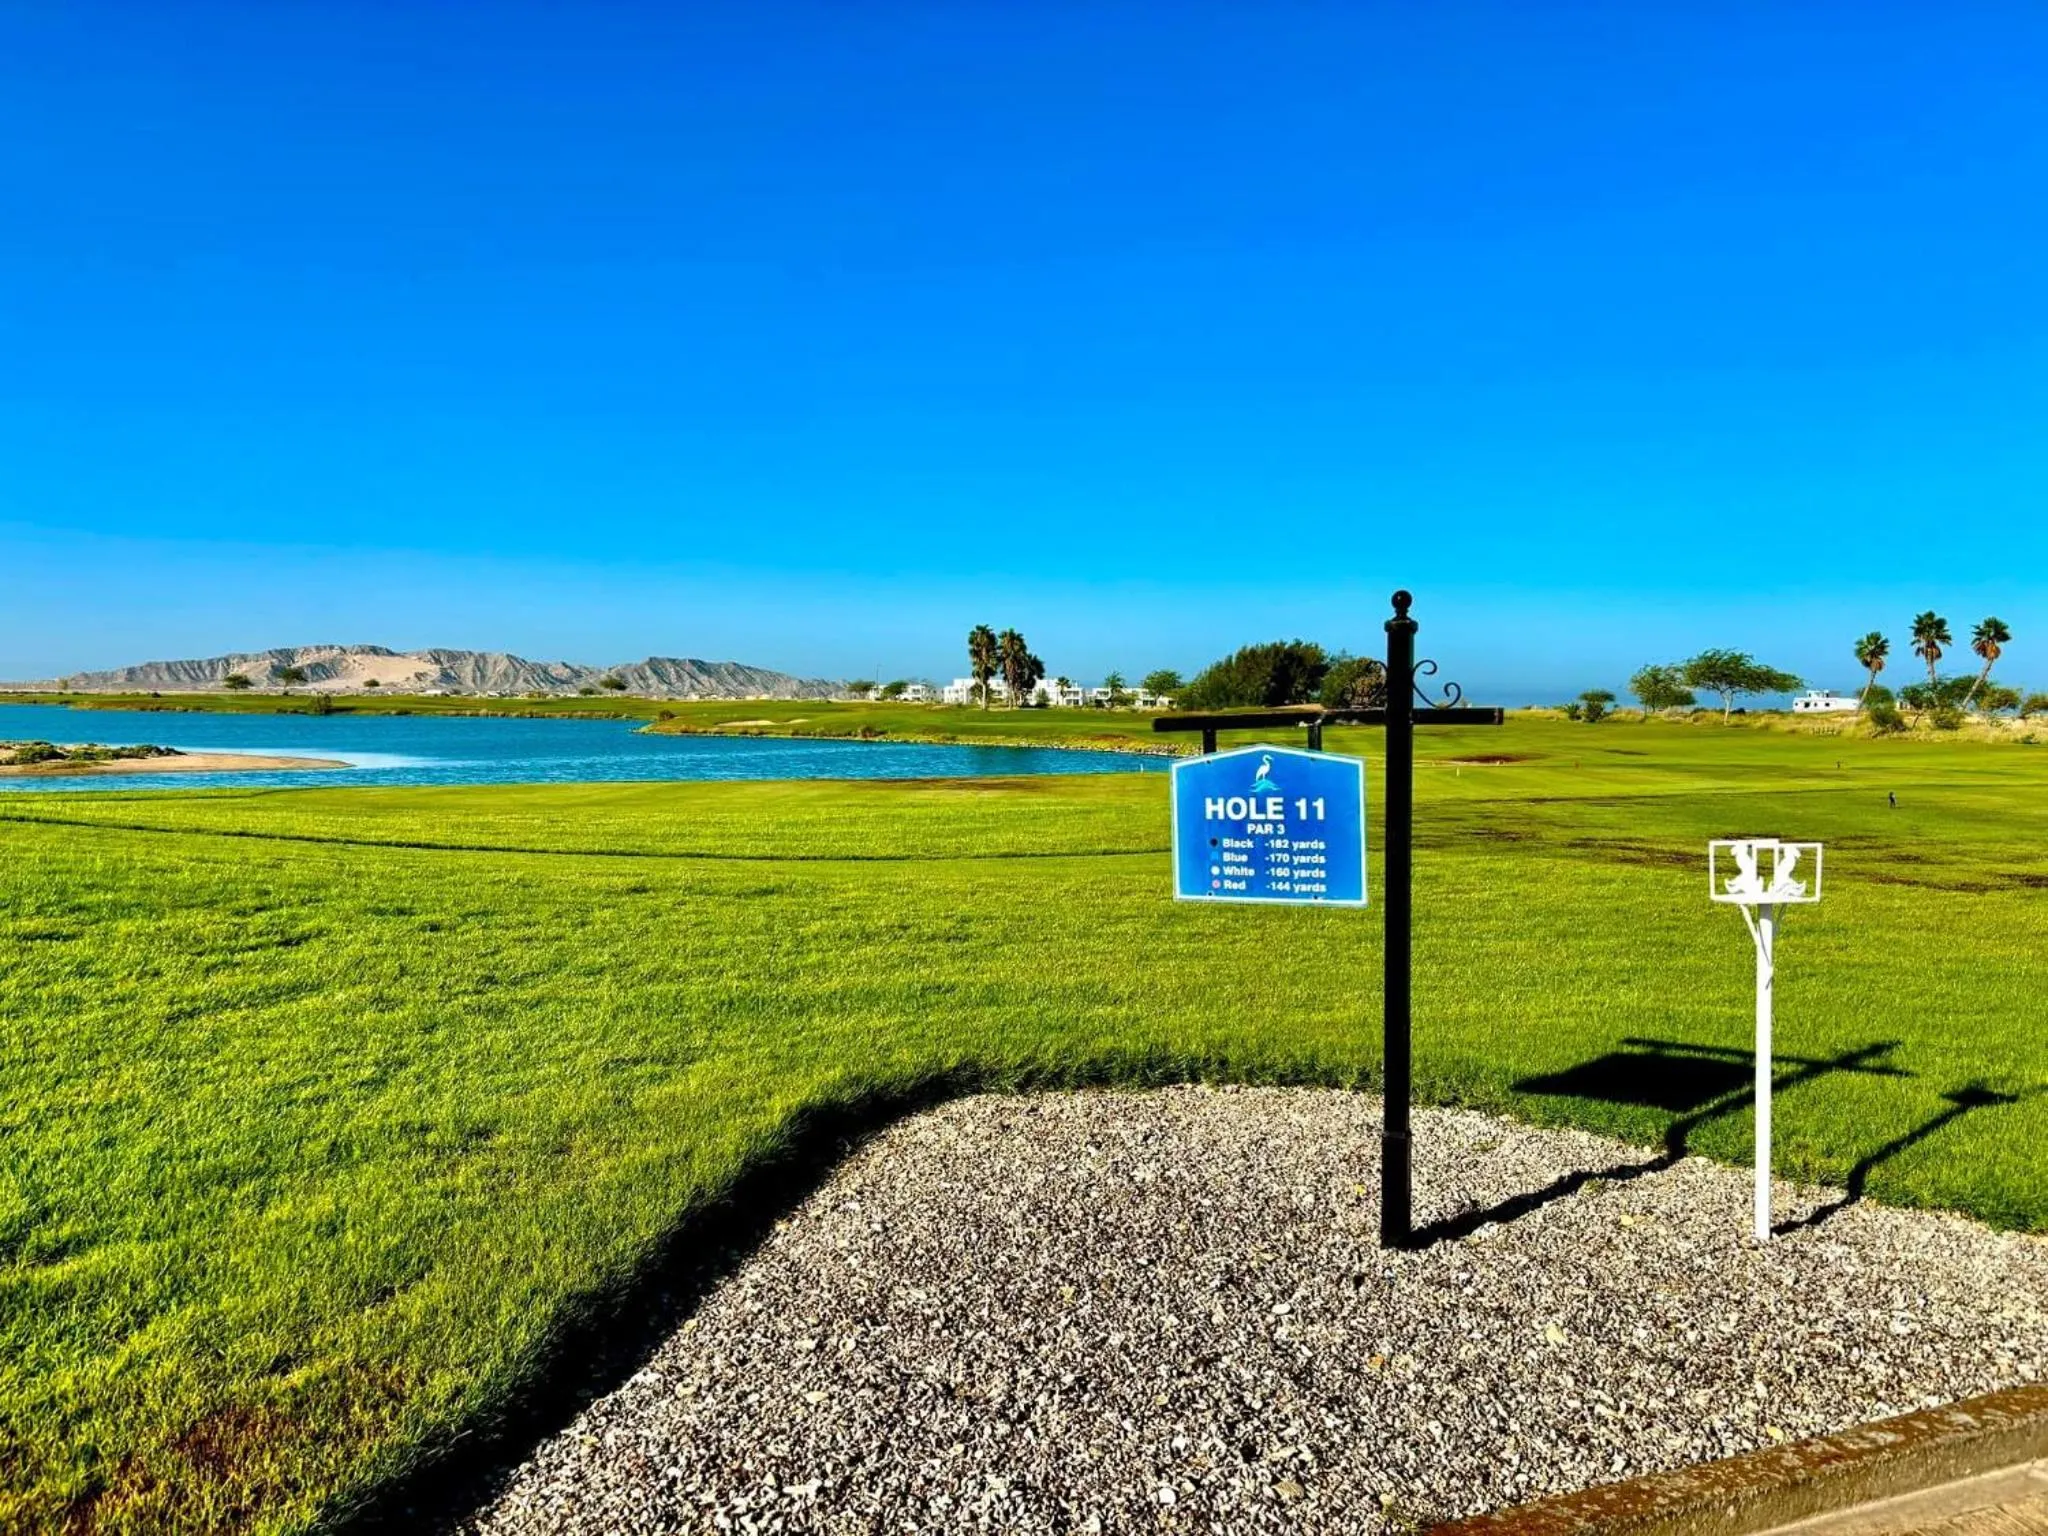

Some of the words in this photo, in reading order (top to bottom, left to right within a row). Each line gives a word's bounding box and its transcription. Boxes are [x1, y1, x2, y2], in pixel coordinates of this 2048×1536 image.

[1205, 797, 1284, 820] HOLE
[1295, 798, 1325, 820] 11
[1247, 824, 1273, 834] PAR
[1277, 824, 1285, 834] 3
[1223, 838, 1254, 848] Black
[1292, 839, 1326, 851] yards
[1223, 853, 1248, 862] Blue
[1265, 853, 1289, 863] -170
[1292, 853, 1326, 864] yards
[1223, 866, 1255, 876] White
[1293, 868, 1326, 879] yards
[1223, 880, 1246, 890] Red
[1266, 881, 1290, 891] -144
[1293, 882, 1327, 893] yards
